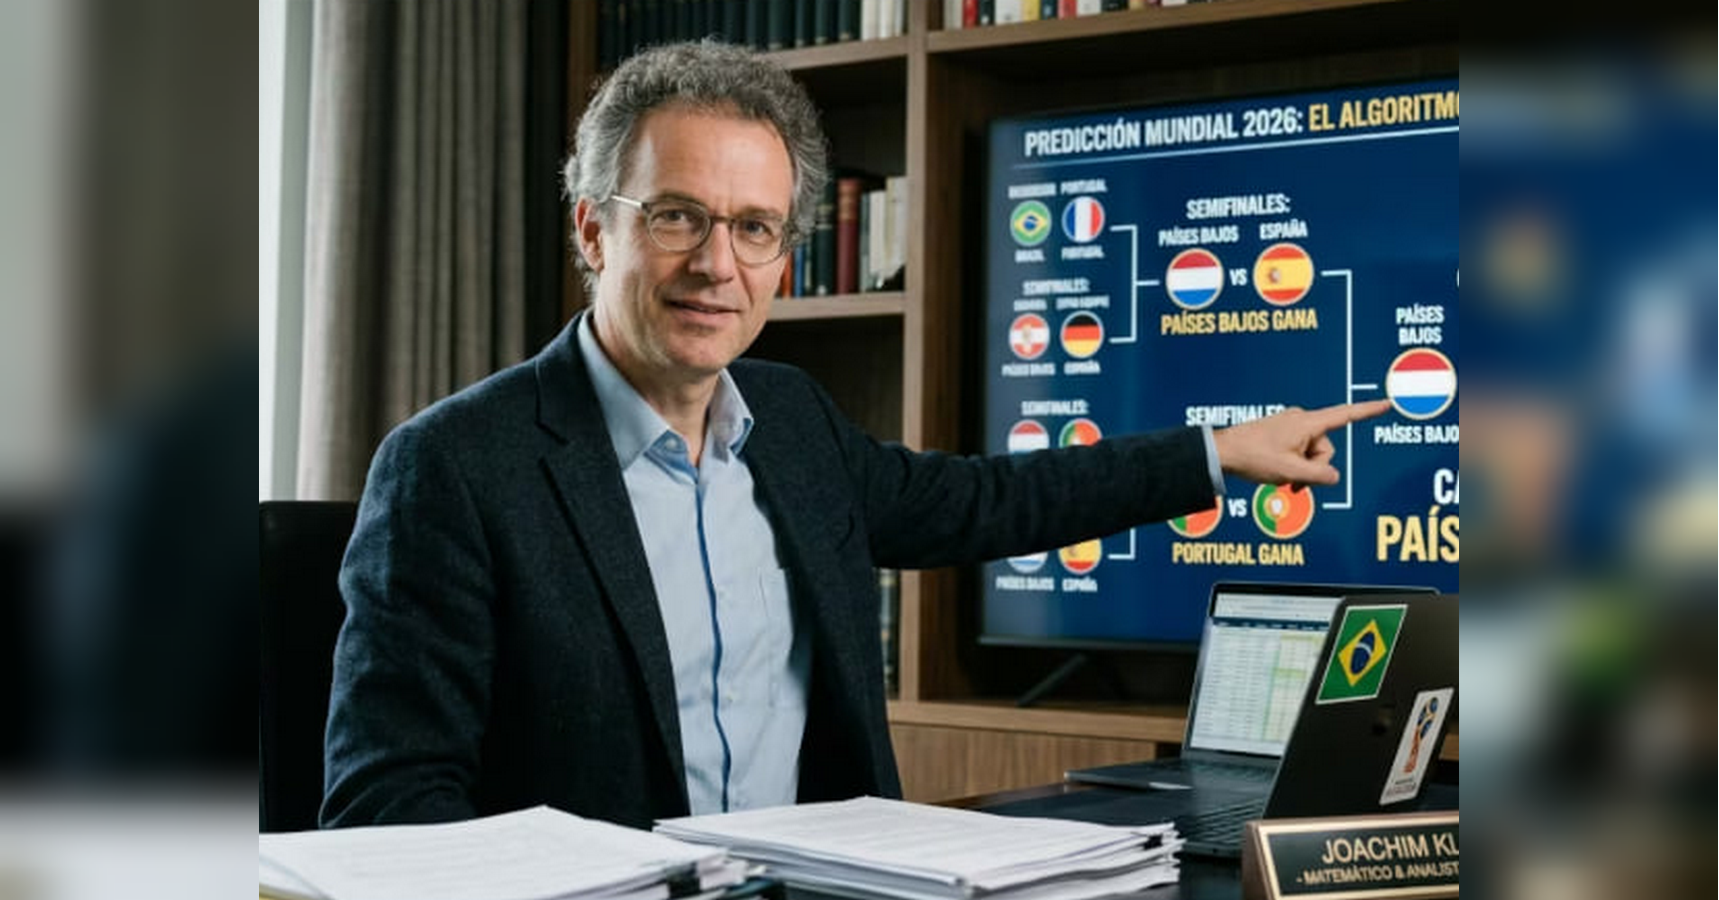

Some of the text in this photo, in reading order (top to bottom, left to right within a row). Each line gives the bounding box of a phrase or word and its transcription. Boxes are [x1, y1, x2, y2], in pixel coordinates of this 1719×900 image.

[1025, 91, 1459, 157] PREDICCIÓN MUNDIAL 2026: EL ALGORITM
[1186, 193, 1291, 219] SEMIFINALES:
[1158, 225, 1240, 246] PAÍSES BAJOS
[1259, 218, 1308, 240] ESPAÑA
[1229, 268, 1247, 286] VS
[1161, 308, 1318, 335] PAÍSES BAJOS GANA
[1395, 302, 1445, 325] PAÍSES
[1398, 325, 1443, 346] BAJOS
[1374, 421, 1422, 444] PAÍSES
[1228, 498, 1247, 517] VS
[1377, 504, 1459, 563] PAÍS
[1172, 542, 1304, 566] PORTUGAL GANA
[1322, 832, 1459, 864] JOACHIM KL
[1303, 865, 1393, 885] MATEMÁTICO
